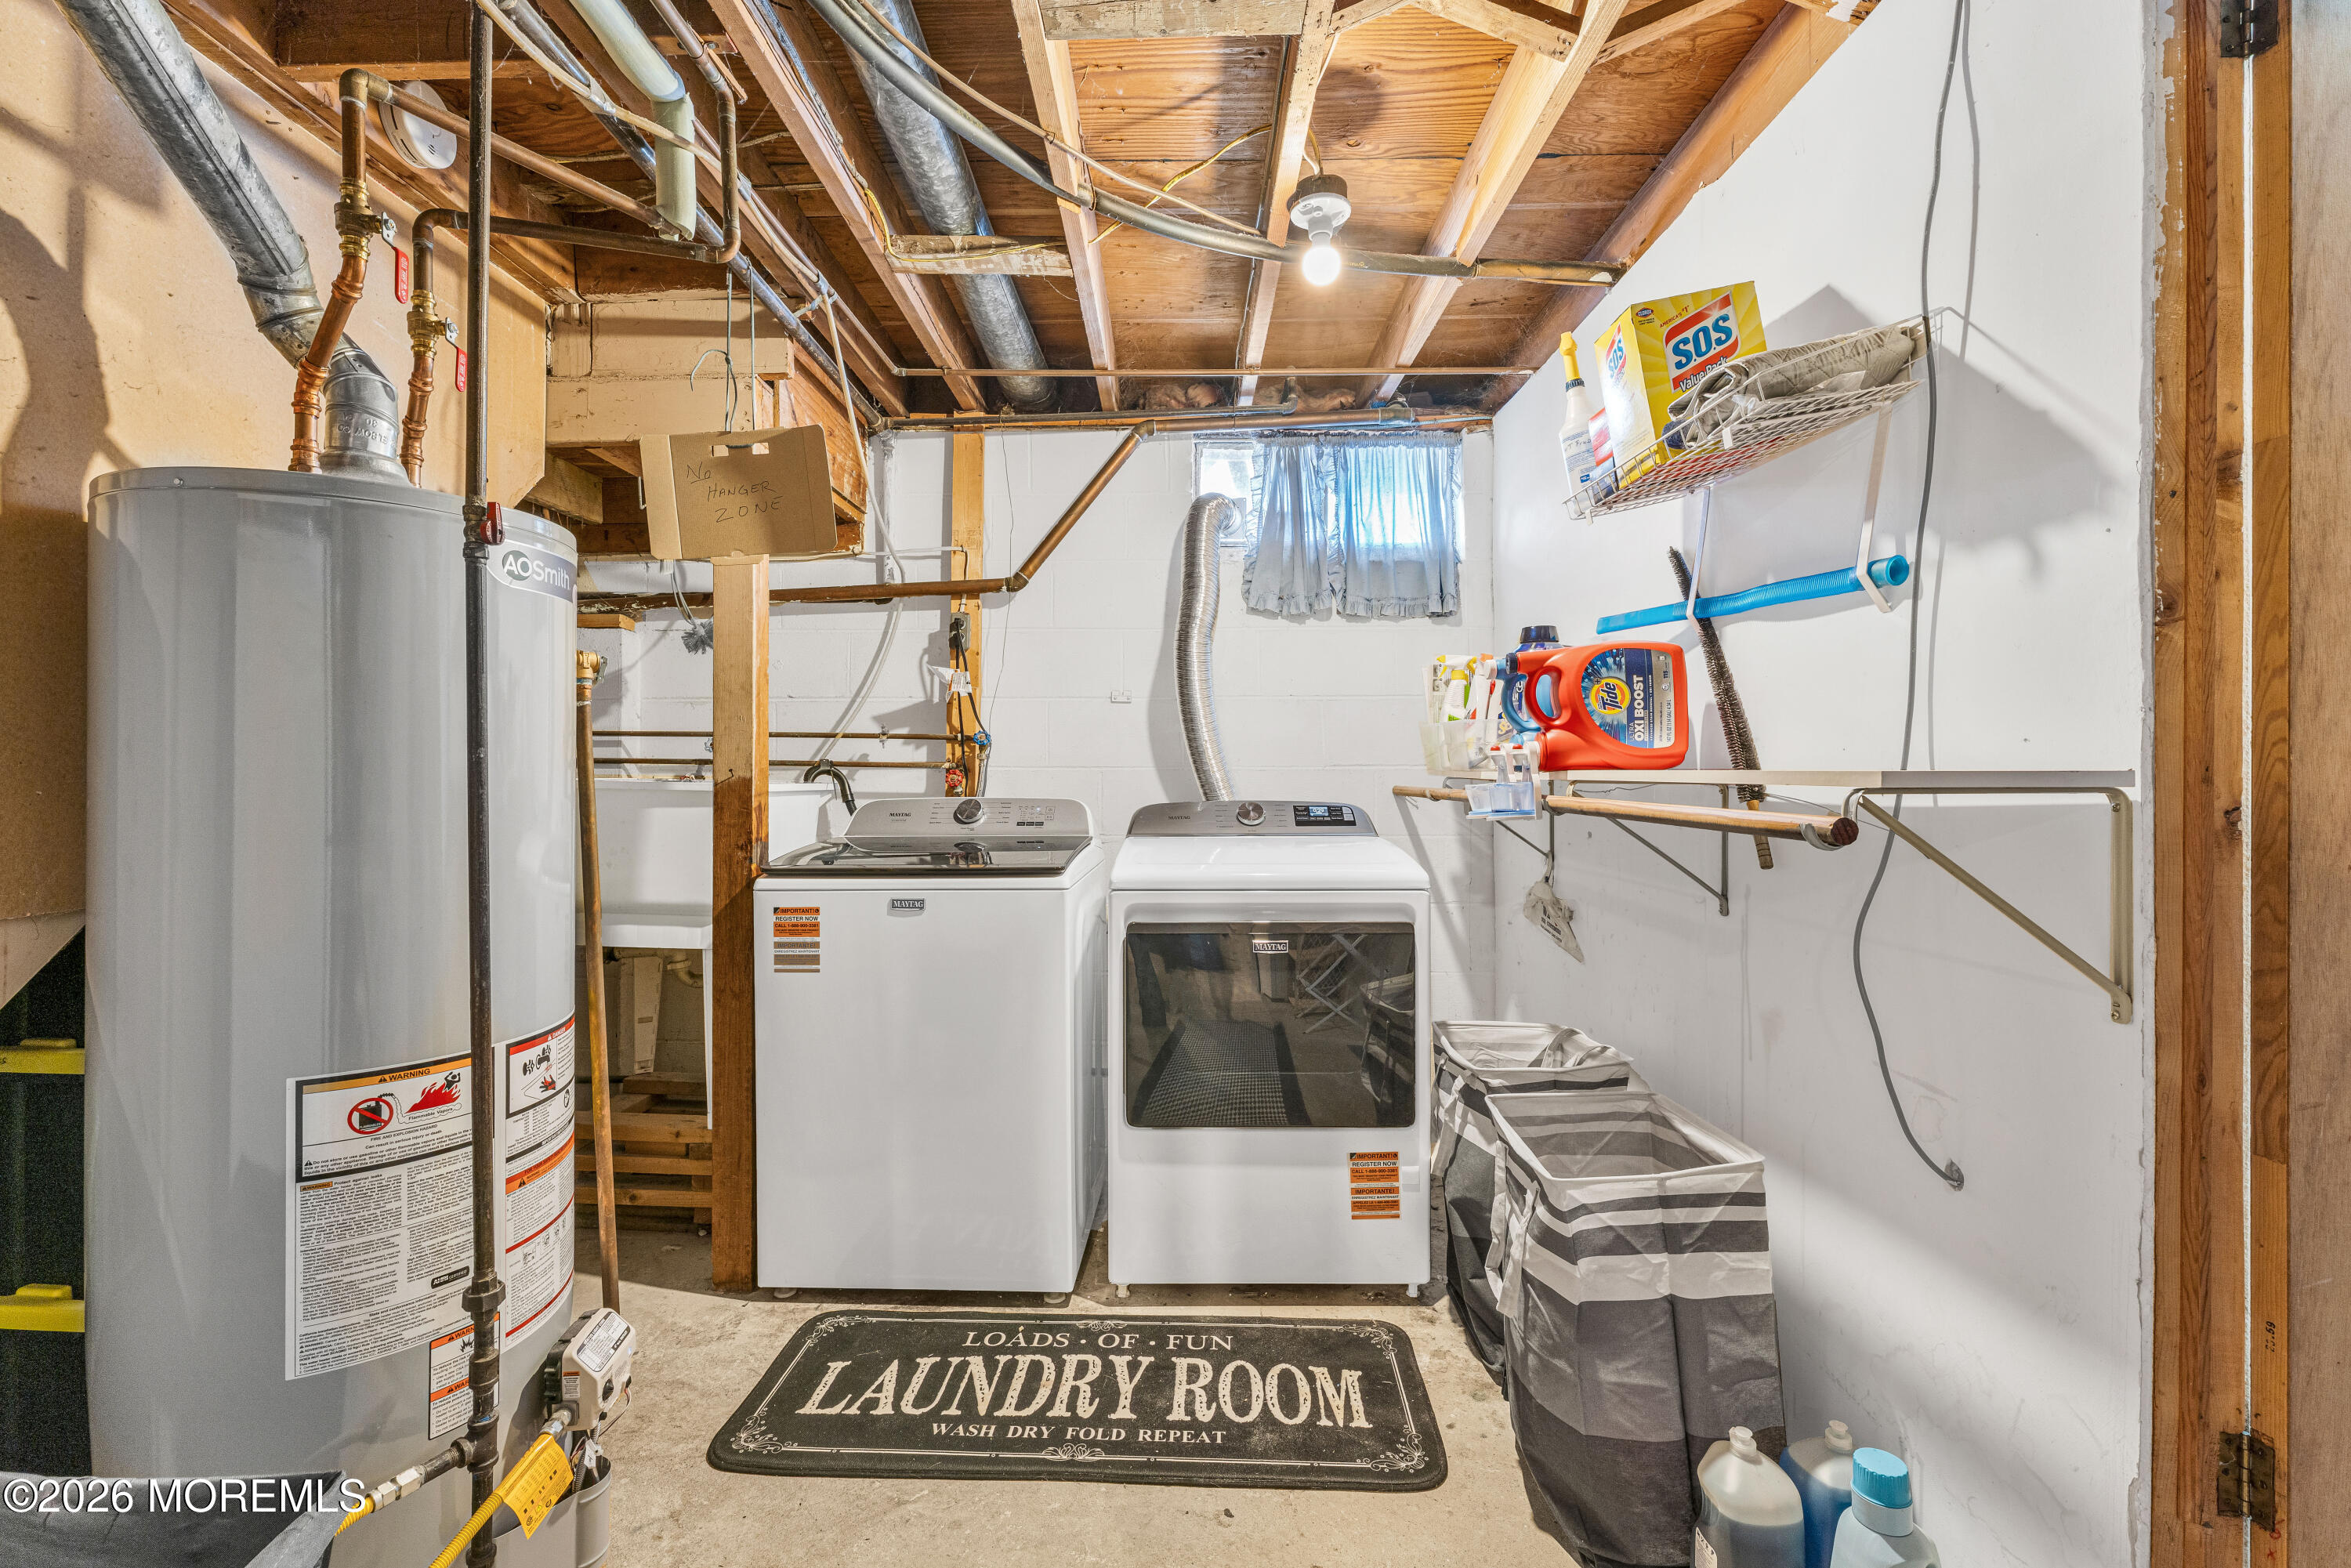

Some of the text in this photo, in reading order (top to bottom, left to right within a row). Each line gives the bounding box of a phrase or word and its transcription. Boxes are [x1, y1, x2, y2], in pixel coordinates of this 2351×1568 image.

[1660, 313, 1683, 328] AMERICA'S
[1679, 370, 1704, 393] Value
[354, 427, 388, 445] ELBOW
[708, 480, 777, 502] HANGER
[715, 496, 783, 523] ZONE
[1600, 682, 1623, 711] Tide
[1633, 675, 1645, 741] OXI BOOST
[893, 900, 923, 908] MAYTAG
[389, 1068, 430, 1081] WARNING
[408, 1111, 435, 1121] Flammable
[393, 1128, 418, 1138] EXPLOSION
[397, 1141, 420, 1150] flammable
[455, 1324, 474, 1338] WARN
[962, 1331, 1233, 1351] LOADS OF FUN
[796, 1355, 1375, 1428] LAUNDRY ROOM
[931, 1423, 1226, 1444] WASH DRY FOLD REPEAT
